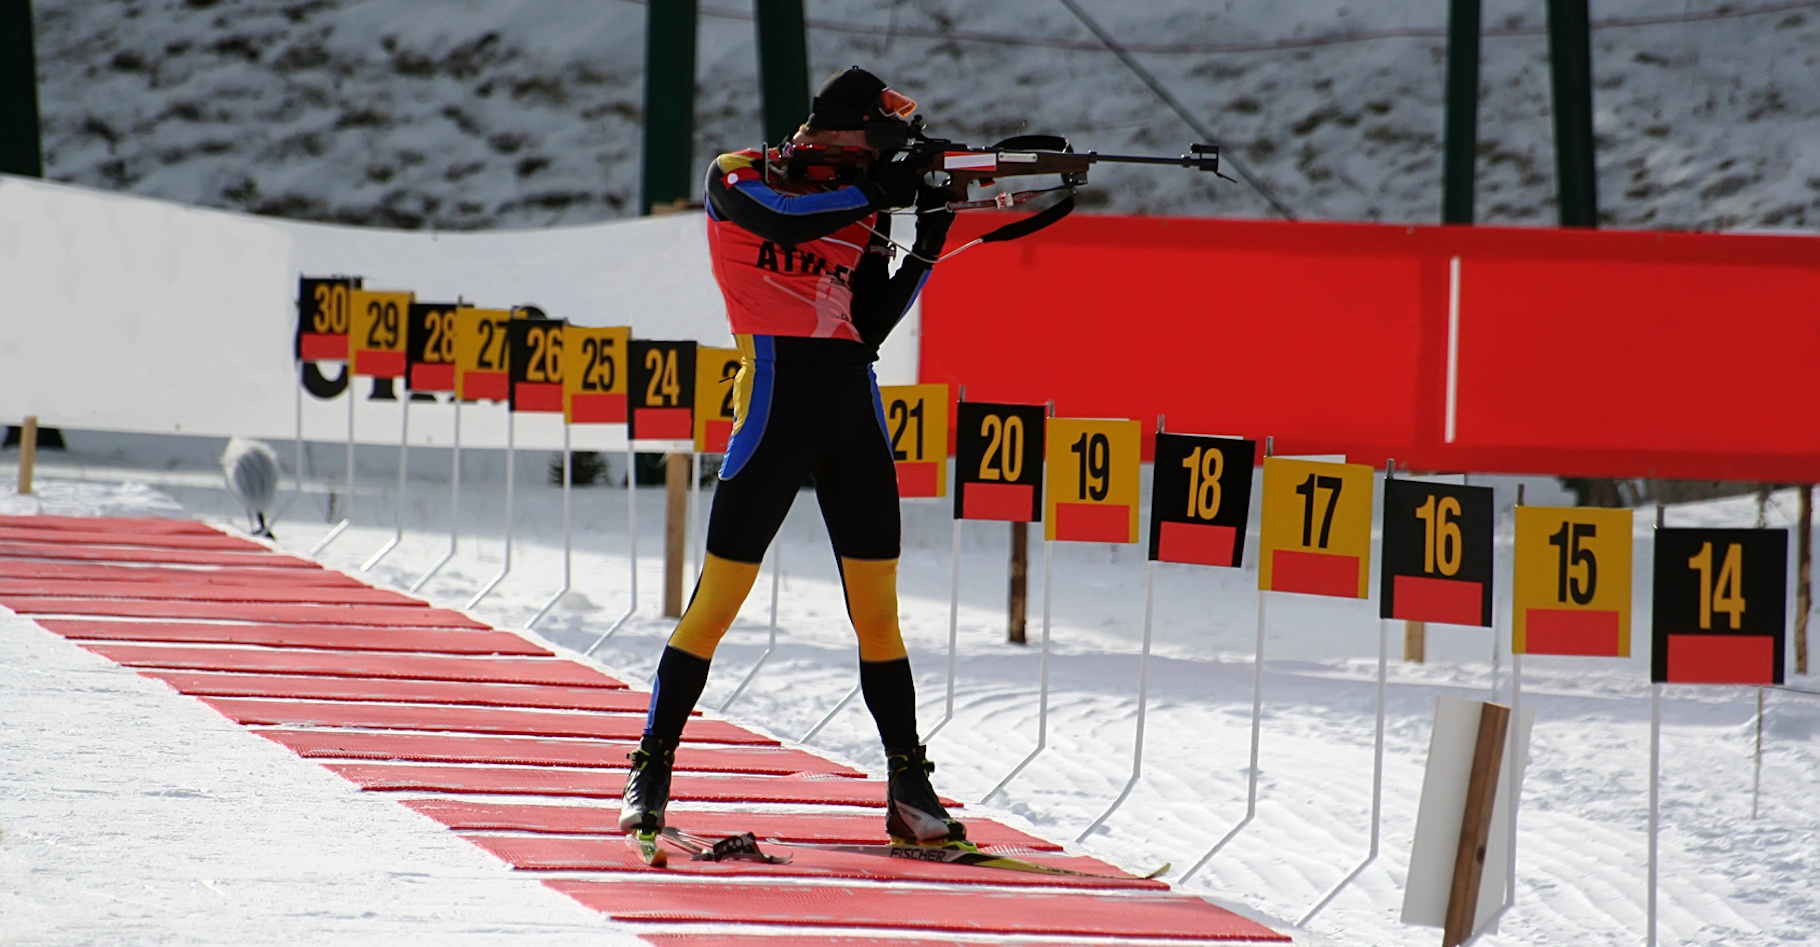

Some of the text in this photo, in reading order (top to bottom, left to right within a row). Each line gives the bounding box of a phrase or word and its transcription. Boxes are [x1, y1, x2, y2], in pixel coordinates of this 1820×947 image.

[313, 283, 348, 334] 30
[367, 301, 399, 349] 29
[423, 310, 456, 362] 28
[477, 319, 510, 369] 27
[526, 327, 563, 382] 26
[582, 337, 615, 392] 25
[645, 348, 680, 406] 24
[720, 360, 740, 417] 2
[889, 399, 924, 461] 21
[979, 414, 1024, 482] 20
[1071, 432, 1110, 502] 19
[1182, 446, 1224, 520] 18
[1296, 473, 1343, 549] 17
[1415, 494, 1462, 576] 16
[1549, 521, 1597, 606] 15
[1688, 541, 1746, 630] 14
[890, 847, 946, 862] FISCHER
